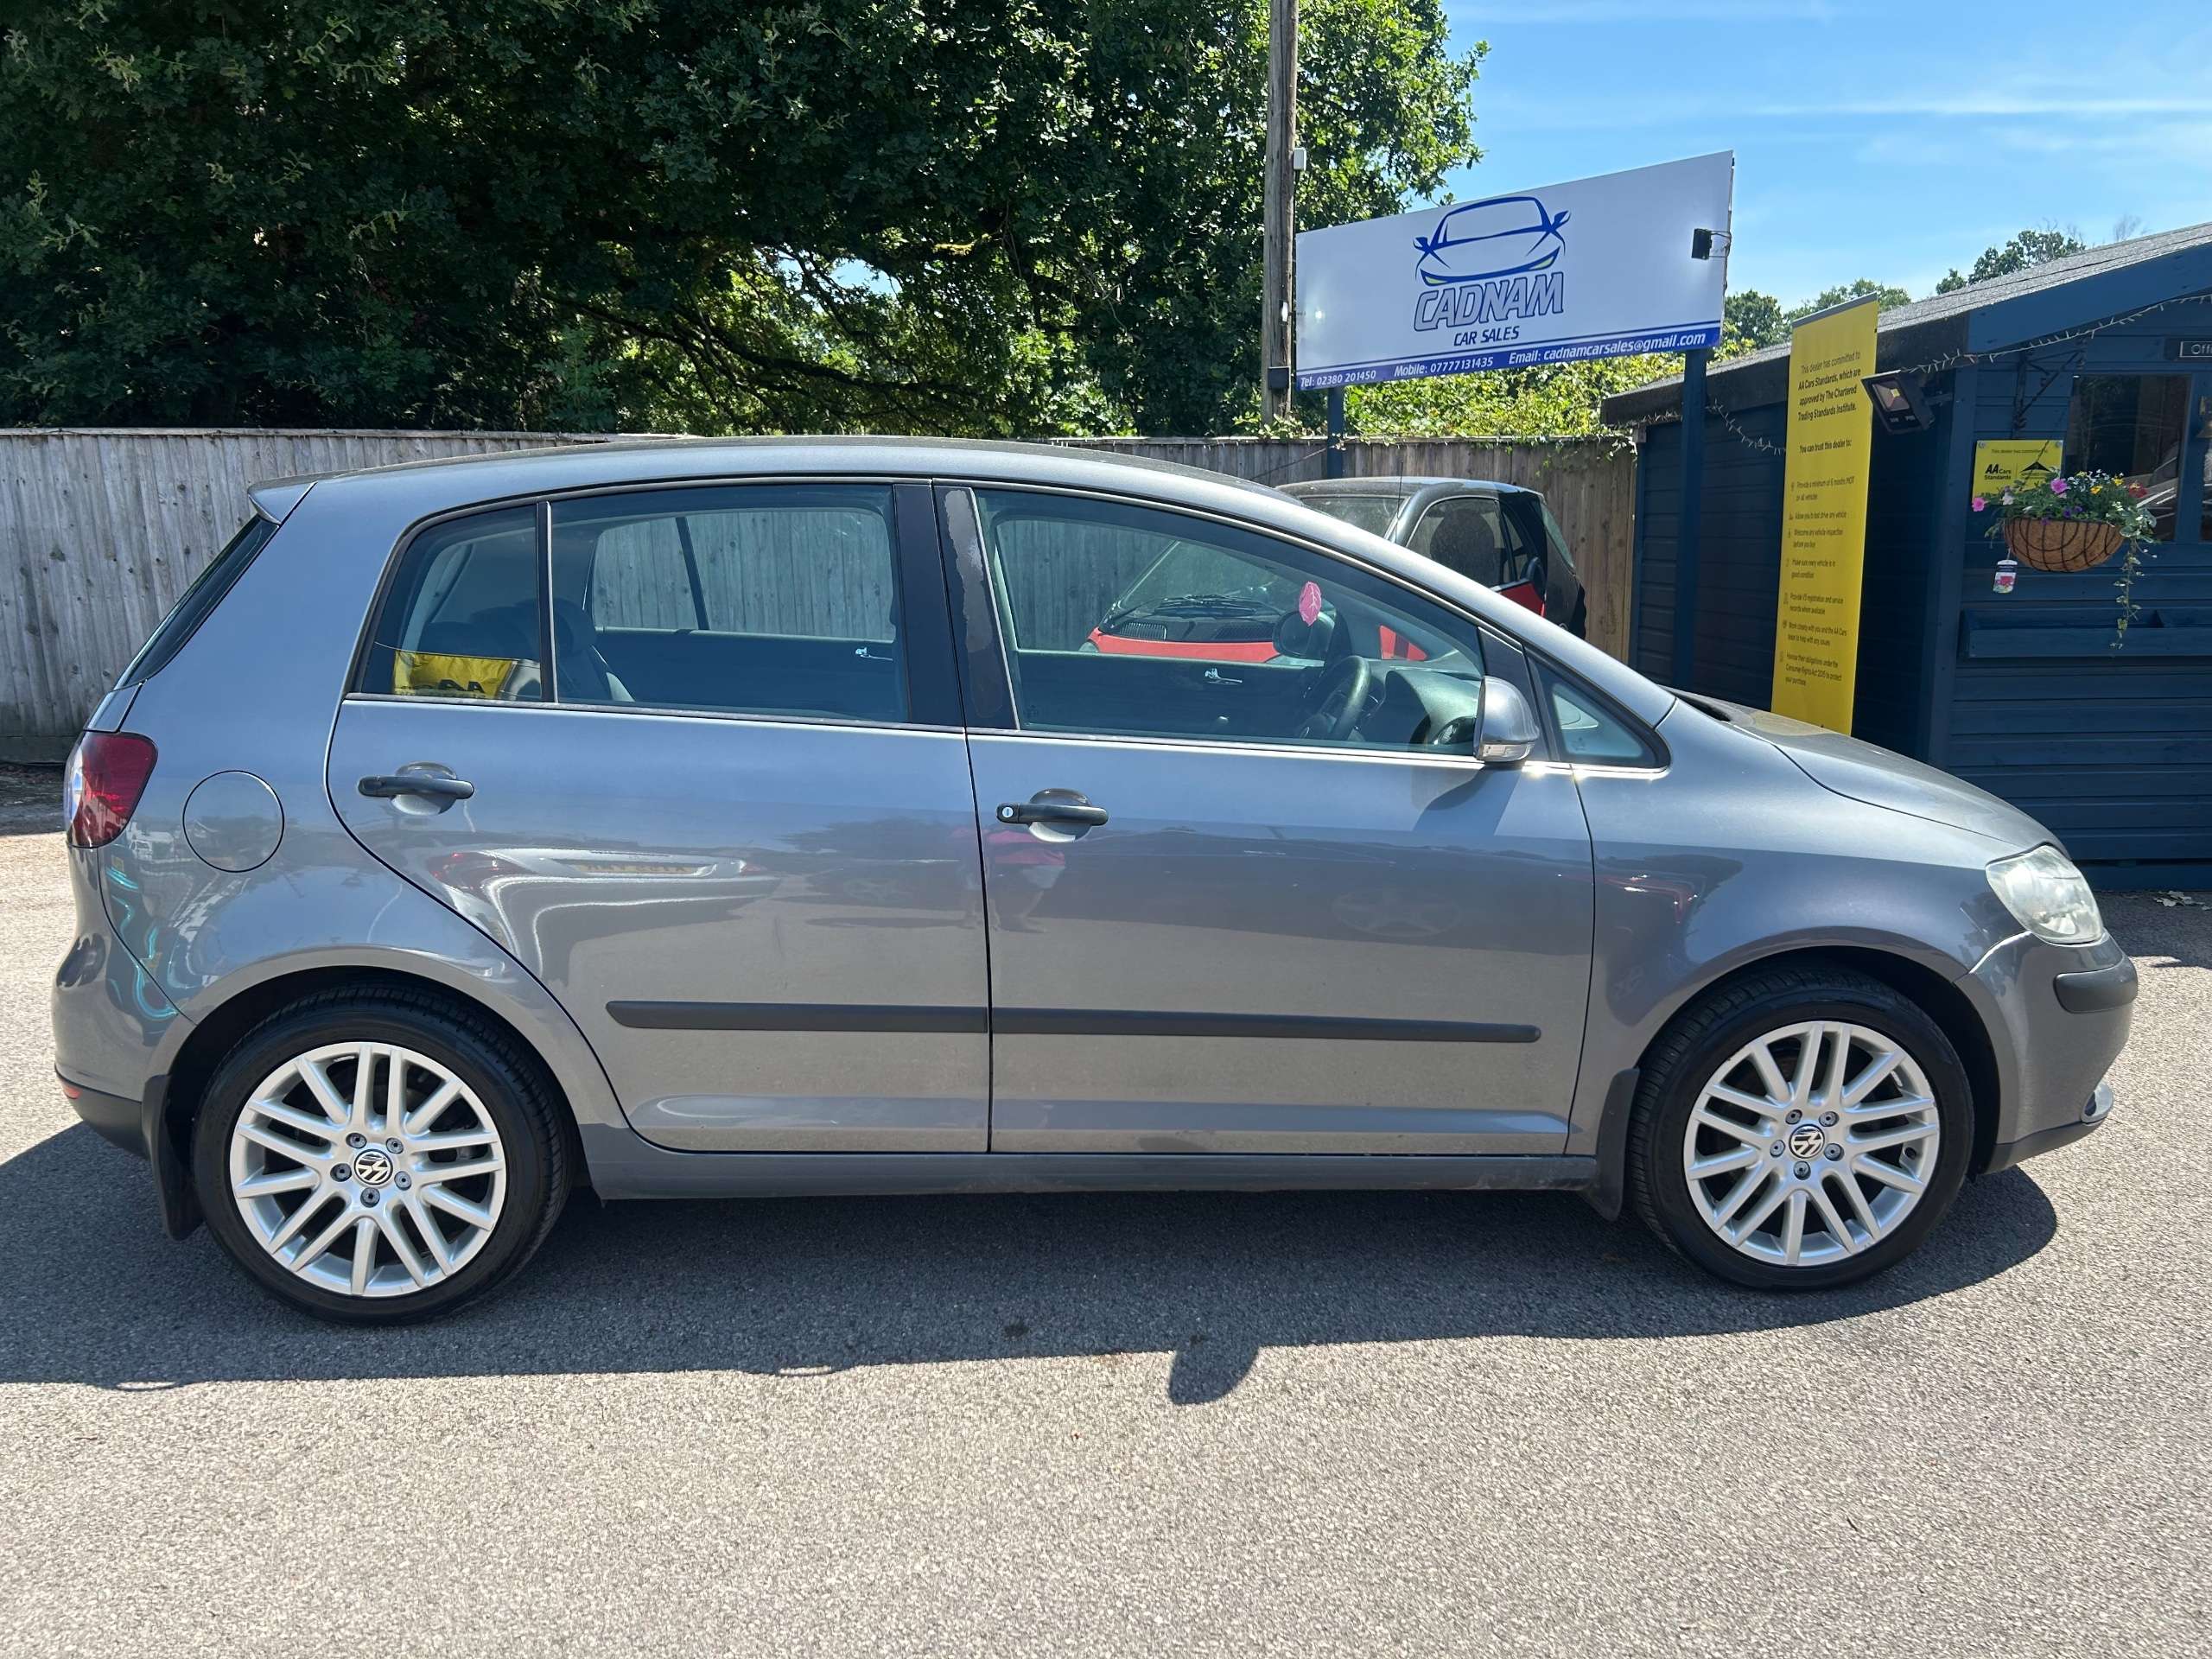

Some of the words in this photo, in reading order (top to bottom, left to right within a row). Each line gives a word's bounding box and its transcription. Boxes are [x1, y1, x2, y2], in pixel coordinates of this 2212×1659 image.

[1414, 271, 1564, 332] CADNAM
[1453, 331, 1478, 346] CAR
[1480, 325, 1520, 344] SALES
[1300, 376, 1314, 388] Tel:
[1316, 374, 1343, 385] 02380
[1344, 370, 1376, 382] 201450
[1394, 364, 1427, 377] Mobile:
[1430, 357, 1494, 372] 07777131435
[1509, 351, 1541, 365] Email:
[1543, 332, 1707, 359] cadnamcarsales@gmail.com
[1839, 371, 1853, 380] which
[1834, 385, 1857, 397] Chartered
[1814, 405, 1835, 418] Standards
[1985, 464, 1999, 474] AA
